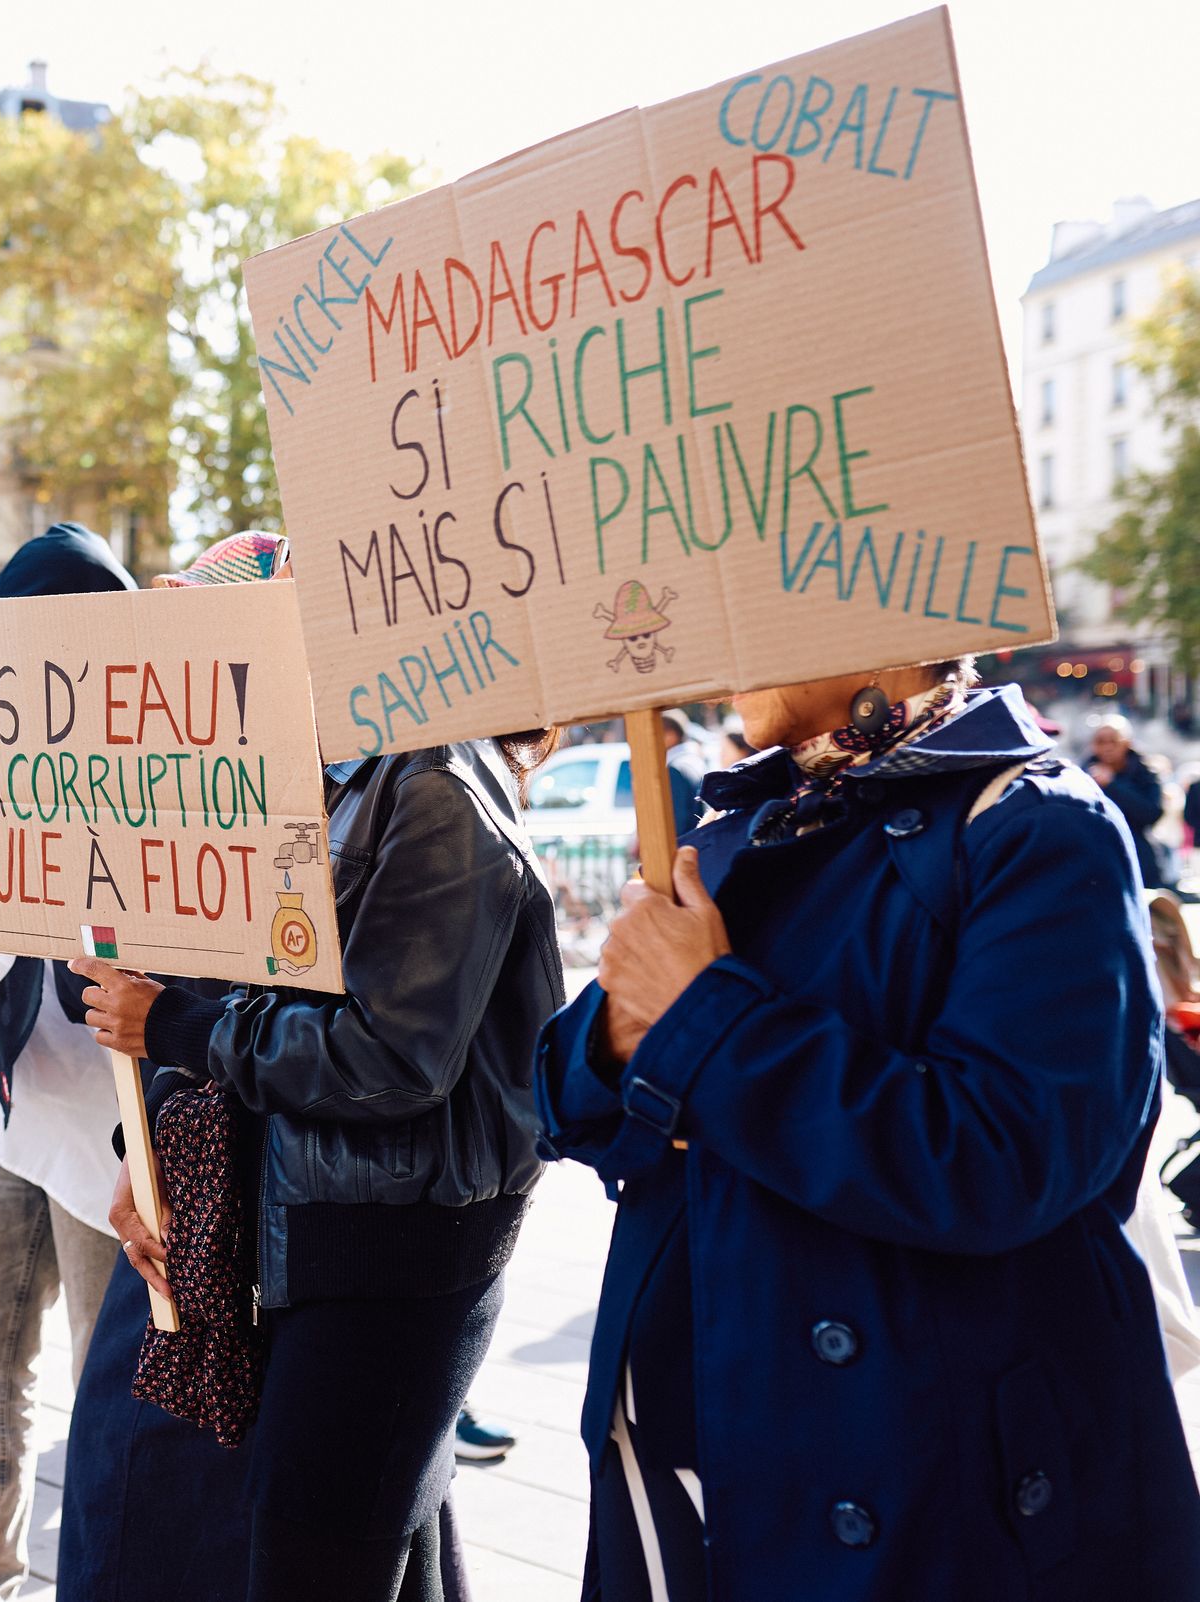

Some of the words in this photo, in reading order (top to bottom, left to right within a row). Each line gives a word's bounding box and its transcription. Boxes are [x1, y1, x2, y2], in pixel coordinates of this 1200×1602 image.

[718, 74, 958, 181] COBALT
[365, 154, 806, 383] MADAGASCAR
[589, 386, 889, 575] PAUVRE
[87, 826, 127, 912] À
[141, 838, 256, 921] FLOT
[287, 930, 304, 947] Ar
